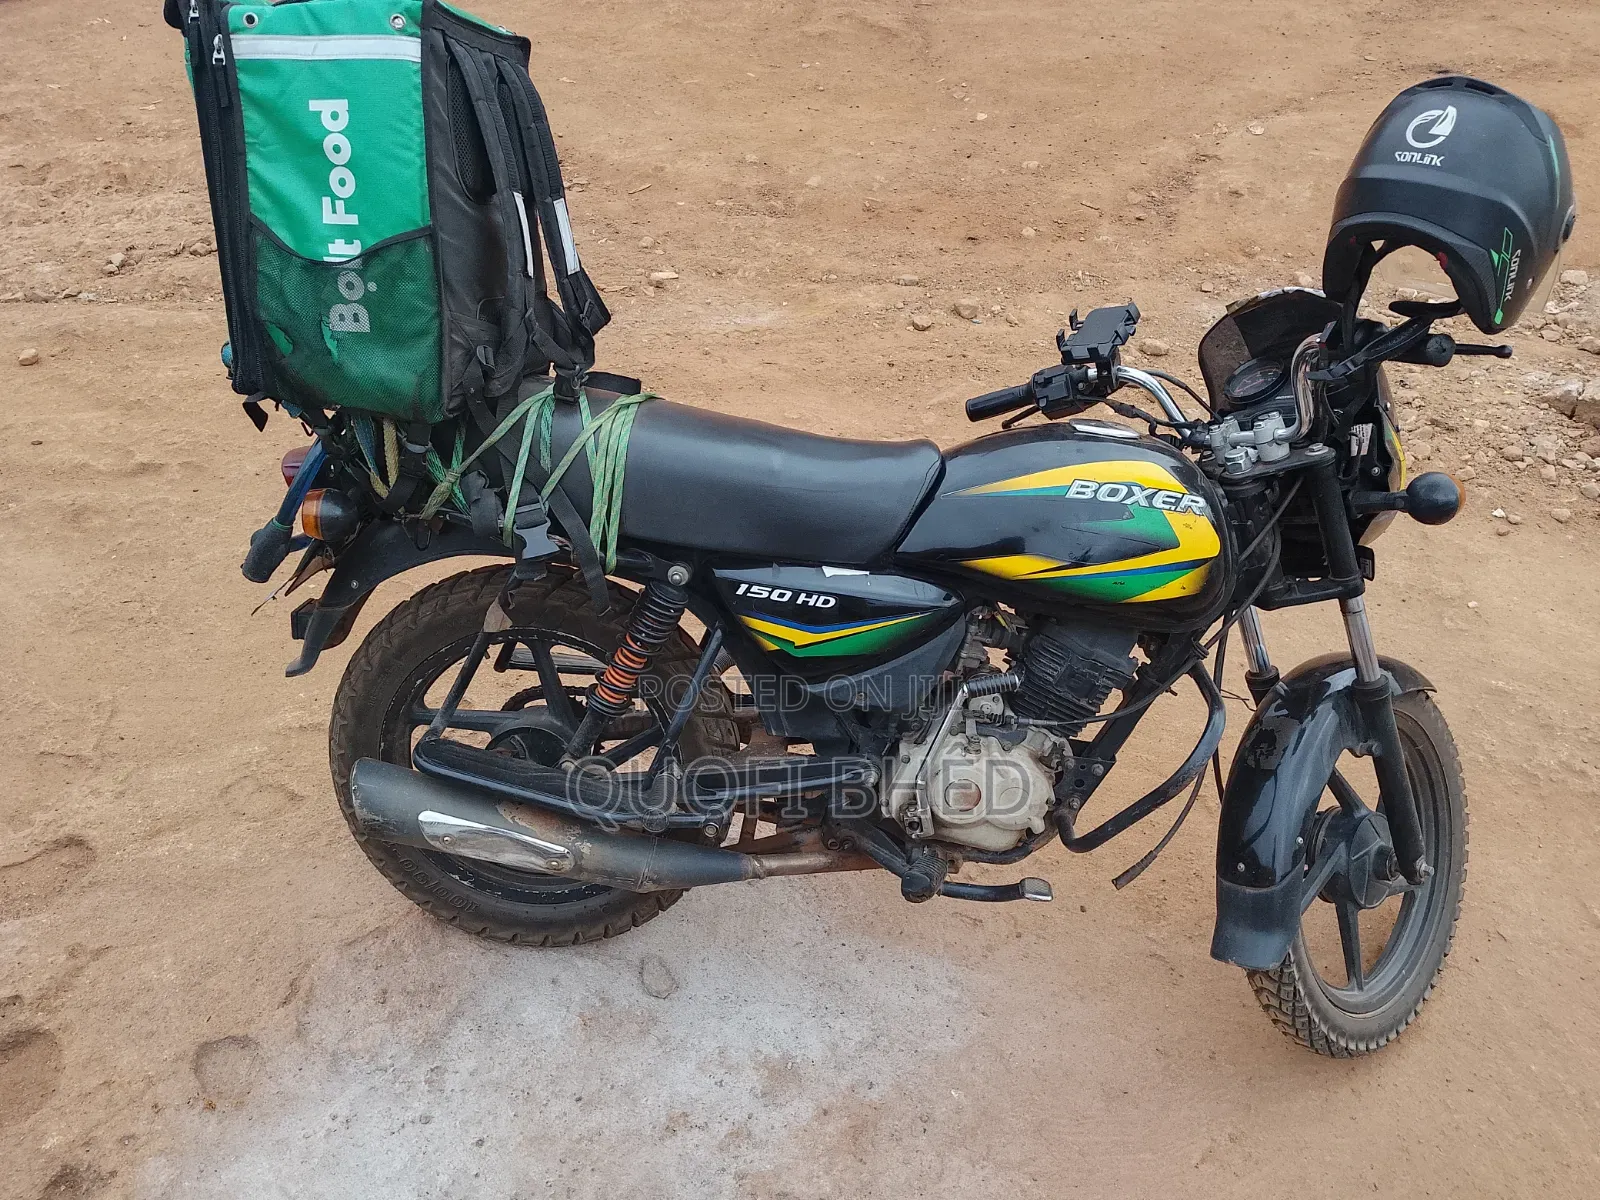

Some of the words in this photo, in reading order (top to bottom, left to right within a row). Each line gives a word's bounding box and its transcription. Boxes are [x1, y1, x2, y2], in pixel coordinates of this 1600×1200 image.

[309, 99, 359, 225] Food
[323, 239, 377, 332] Bolt
[1065, 479, 1208, 516] BOXER
[735, 583, 793, 602] 150
[796, 593, 836, 609] HD
